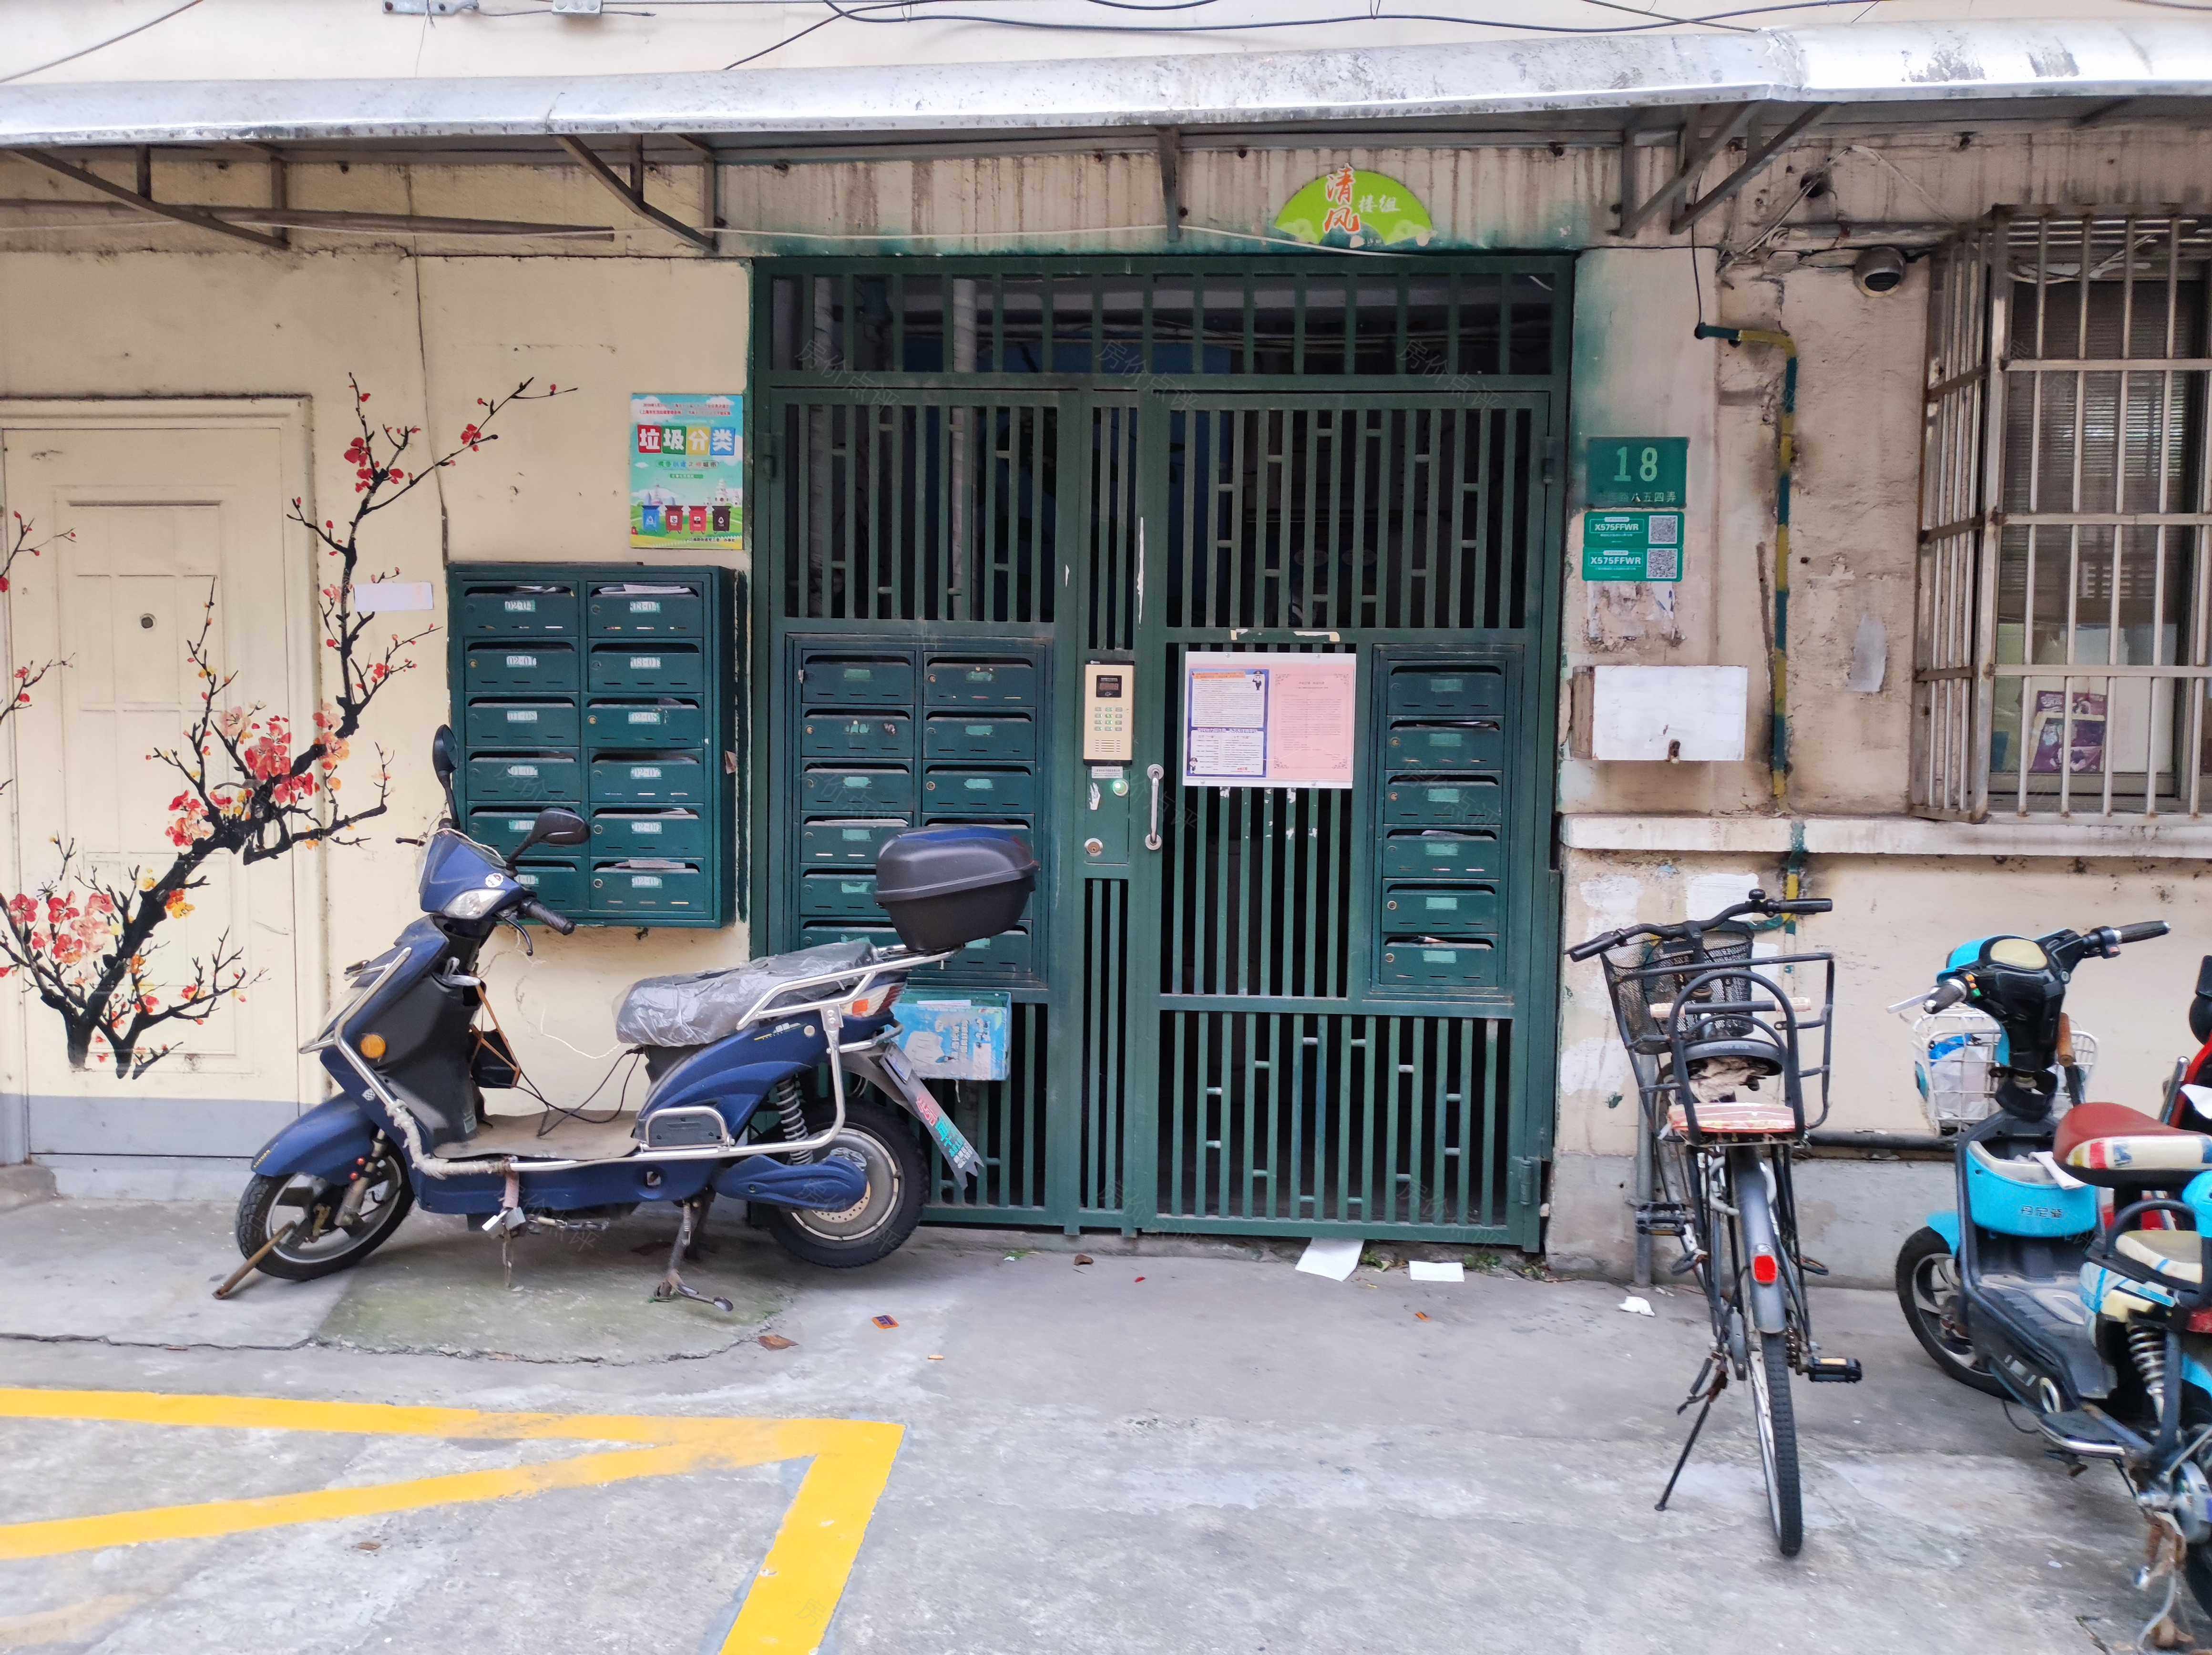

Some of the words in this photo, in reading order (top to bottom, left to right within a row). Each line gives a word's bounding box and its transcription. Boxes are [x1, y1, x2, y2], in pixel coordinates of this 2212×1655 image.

[1323, 163, 1361, 234] 清风
[639, 428, 733, 452] 垃圾分类
[1614, 446, 1658, 482] 18
[1590, 556, 1642, 565] X575FFWR
